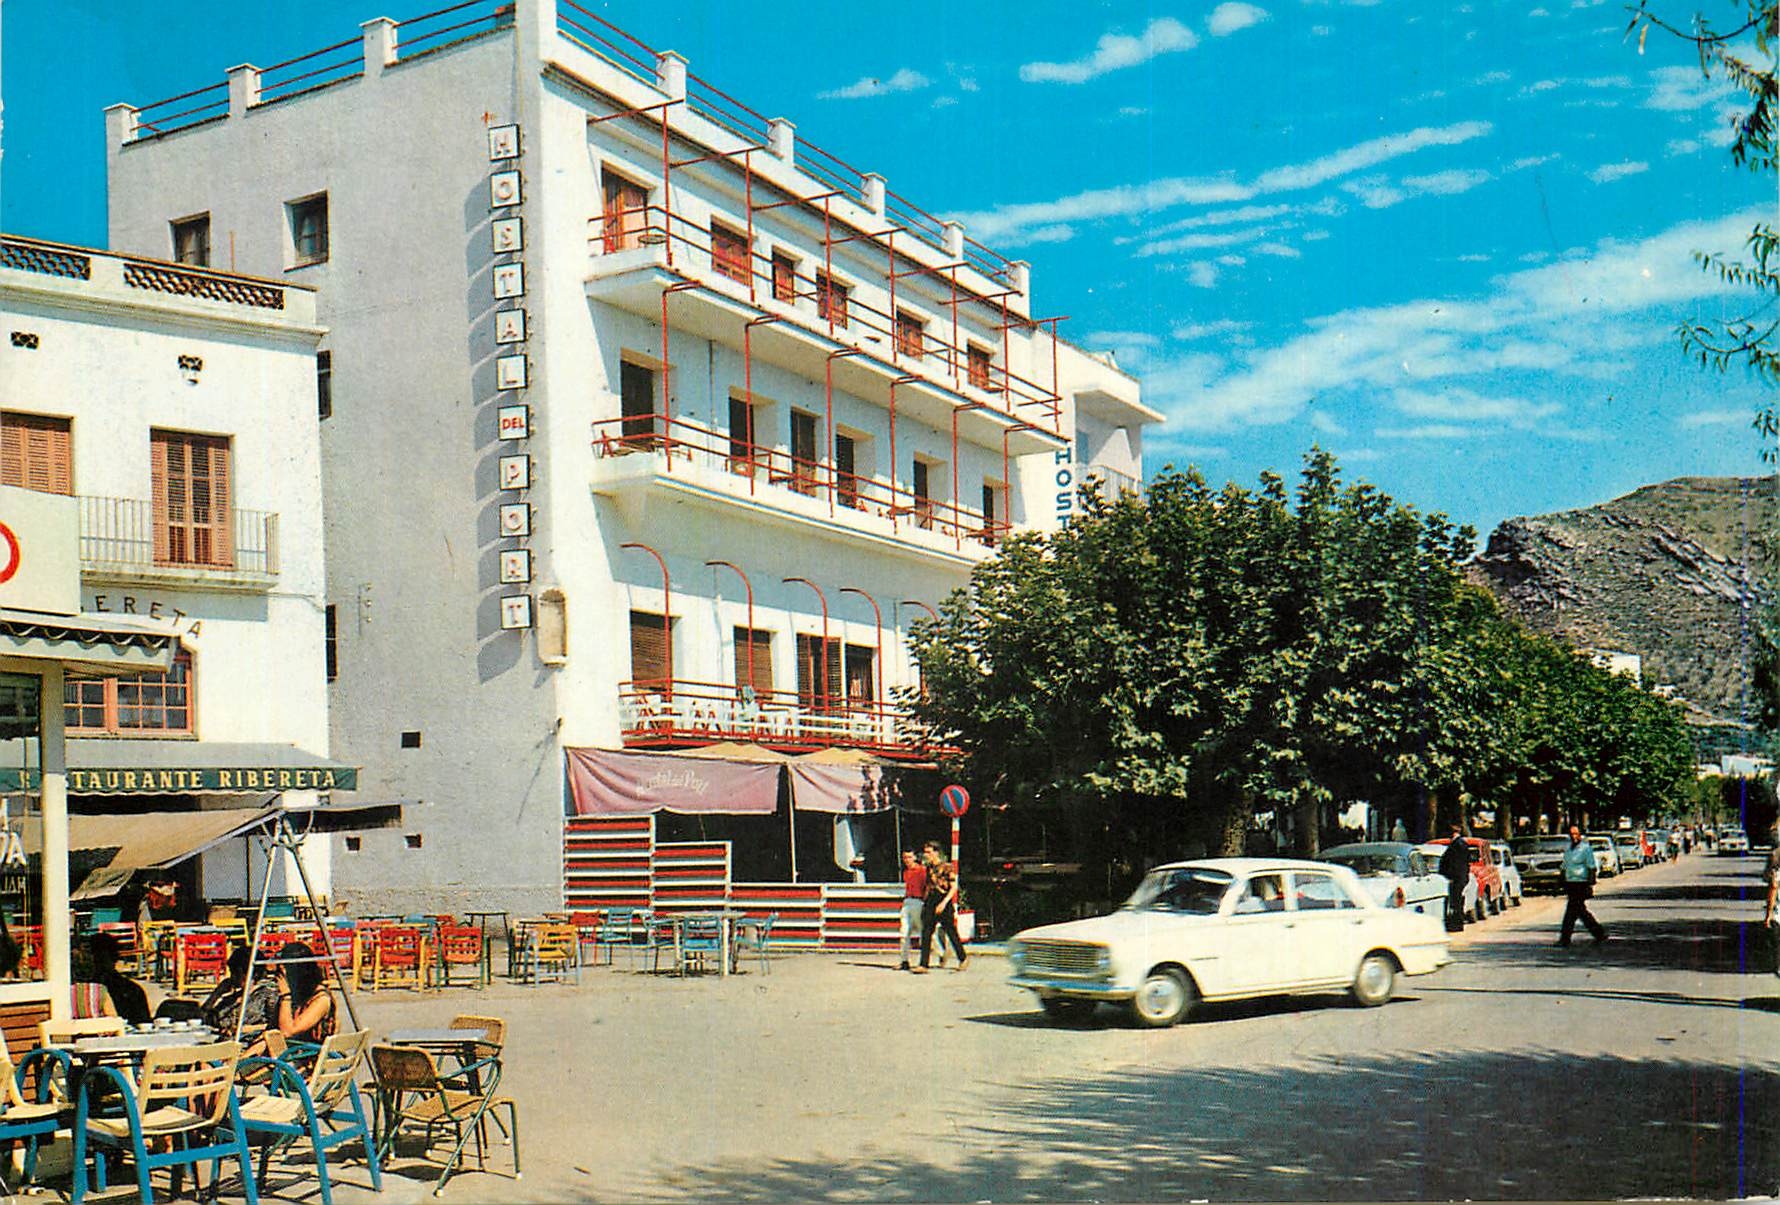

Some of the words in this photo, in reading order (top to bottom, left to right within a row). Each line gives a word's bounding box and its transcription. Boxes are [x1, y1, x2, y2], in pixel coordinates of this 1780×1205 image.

[493, 131, 519, 385] HOSTAL
[501, 416, 525, 431] DEL
[504, 462, 525, 624] PORT
[81, 595, 202, 638] ERETA
[19, 770, 203, 789] RTAURANTE
[219, 769, 336, 788] RIBERETA
